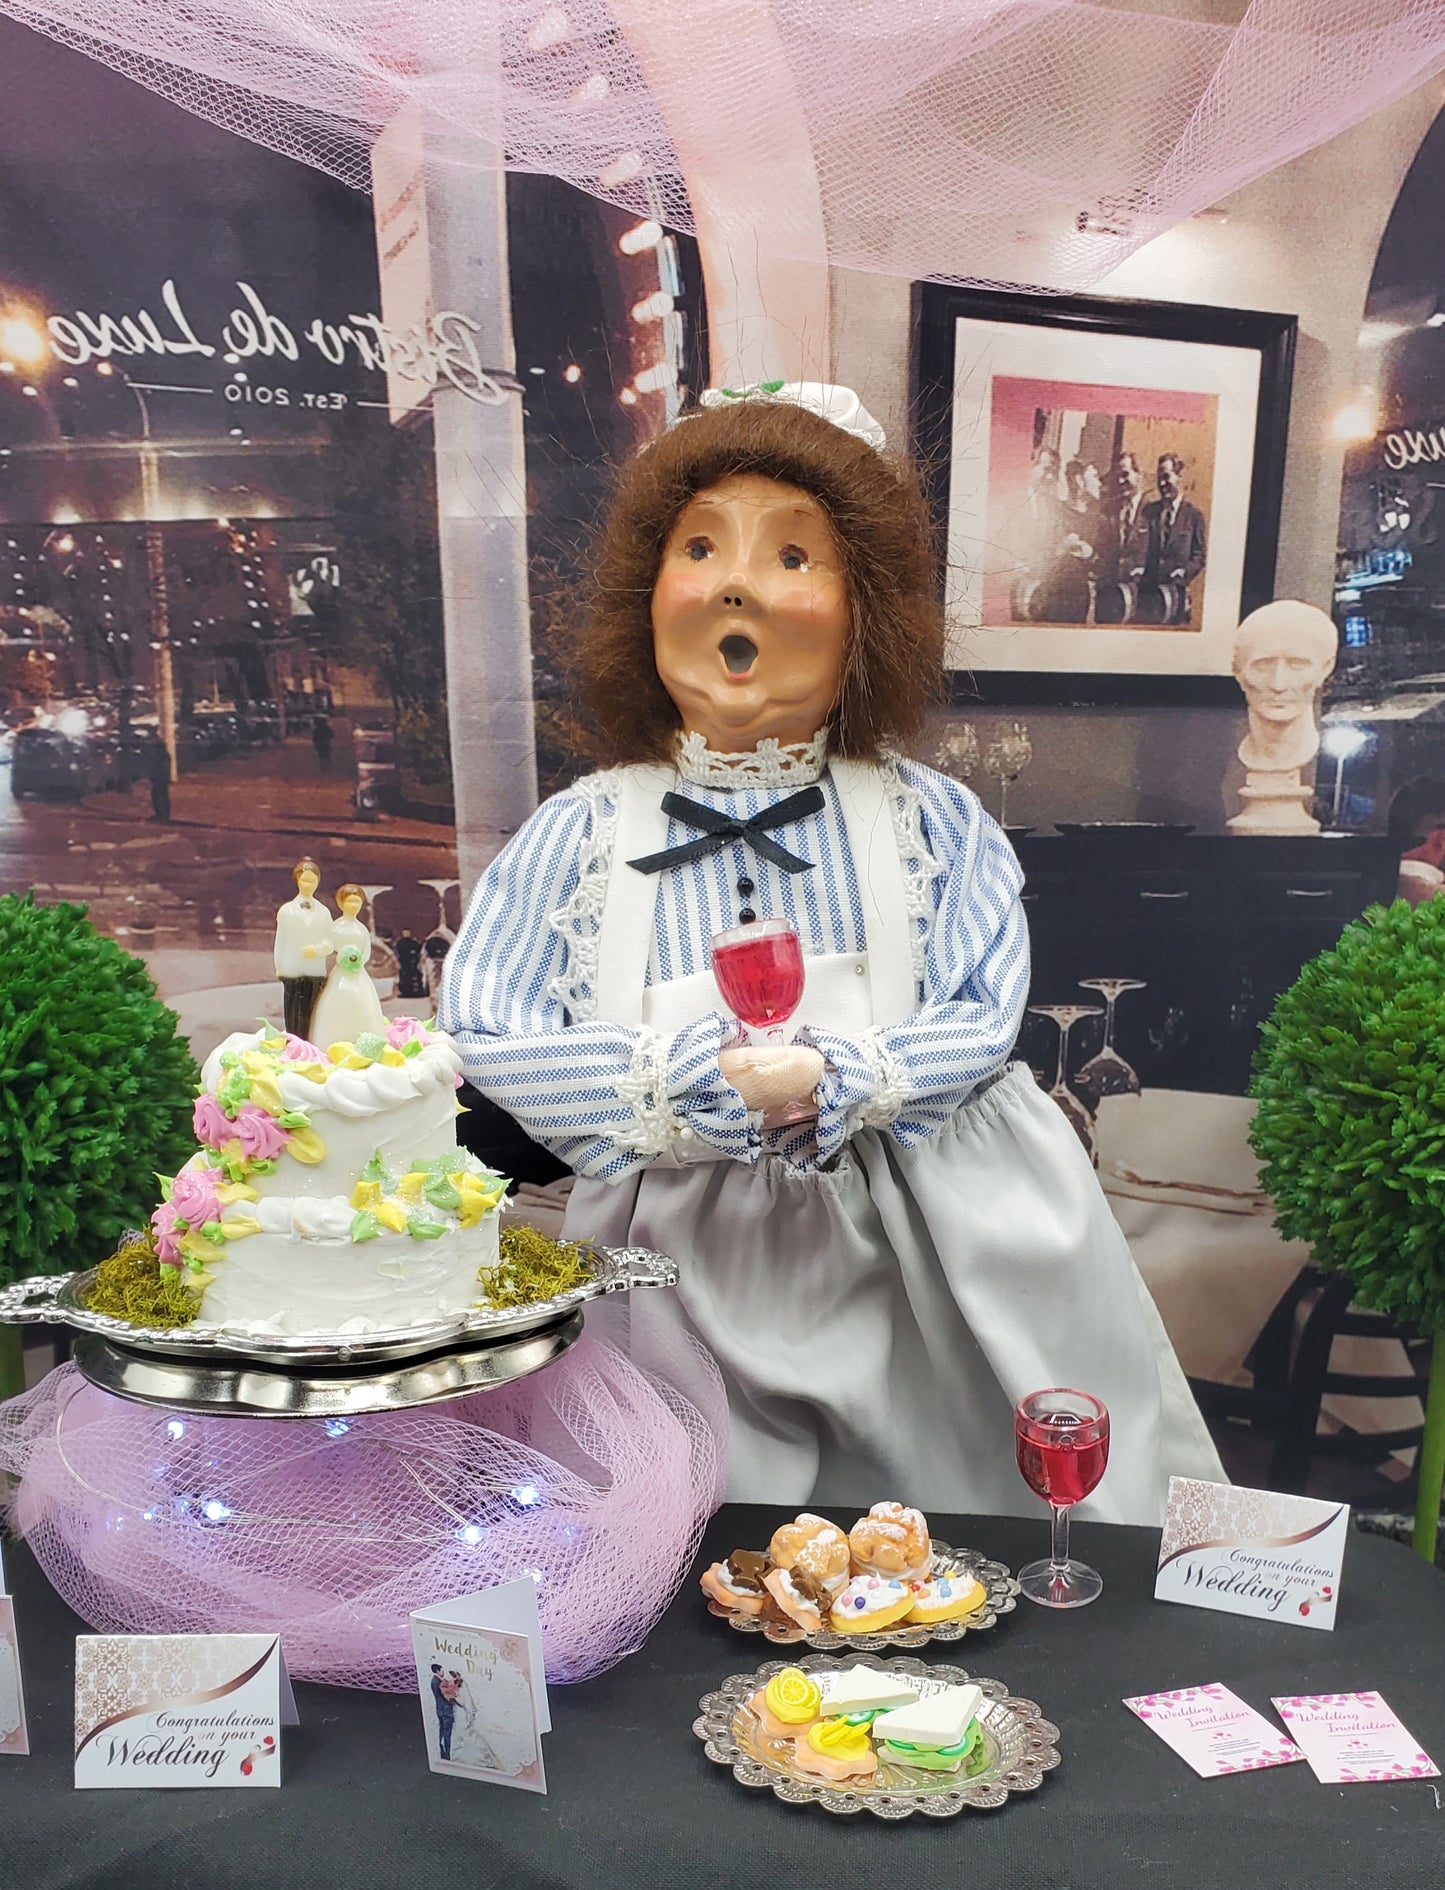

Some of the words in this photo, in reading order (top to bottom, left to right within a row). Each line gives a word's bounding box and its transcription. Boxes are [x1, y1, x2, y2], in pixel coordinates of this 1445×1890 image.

[1226, 1548, 1335, 1579] Congratulations
[1175, 1559, 1292, 1612] Wedding
[1265, 1571, 1279, 1581] on
[1285, 1573, 1317, 1588] your
[434, 1636, 498, 1665] Wedding
[466, 1659, 493, 1682] Day
[152, 1709, 275, 1734] Congratulations
[1154, 1704, 1214, 1720] Wedding
[1184, 1711, 1251, 1728] Invitation
[1296, 1712, 1360, 1722] Wedding
[1328, 1721, 1397, 1733] Invitation
[200, 1731, 215, 1740] on
[220, 1731, 256, 1747] your
[96, 1734, 231, 1778] Wedding
